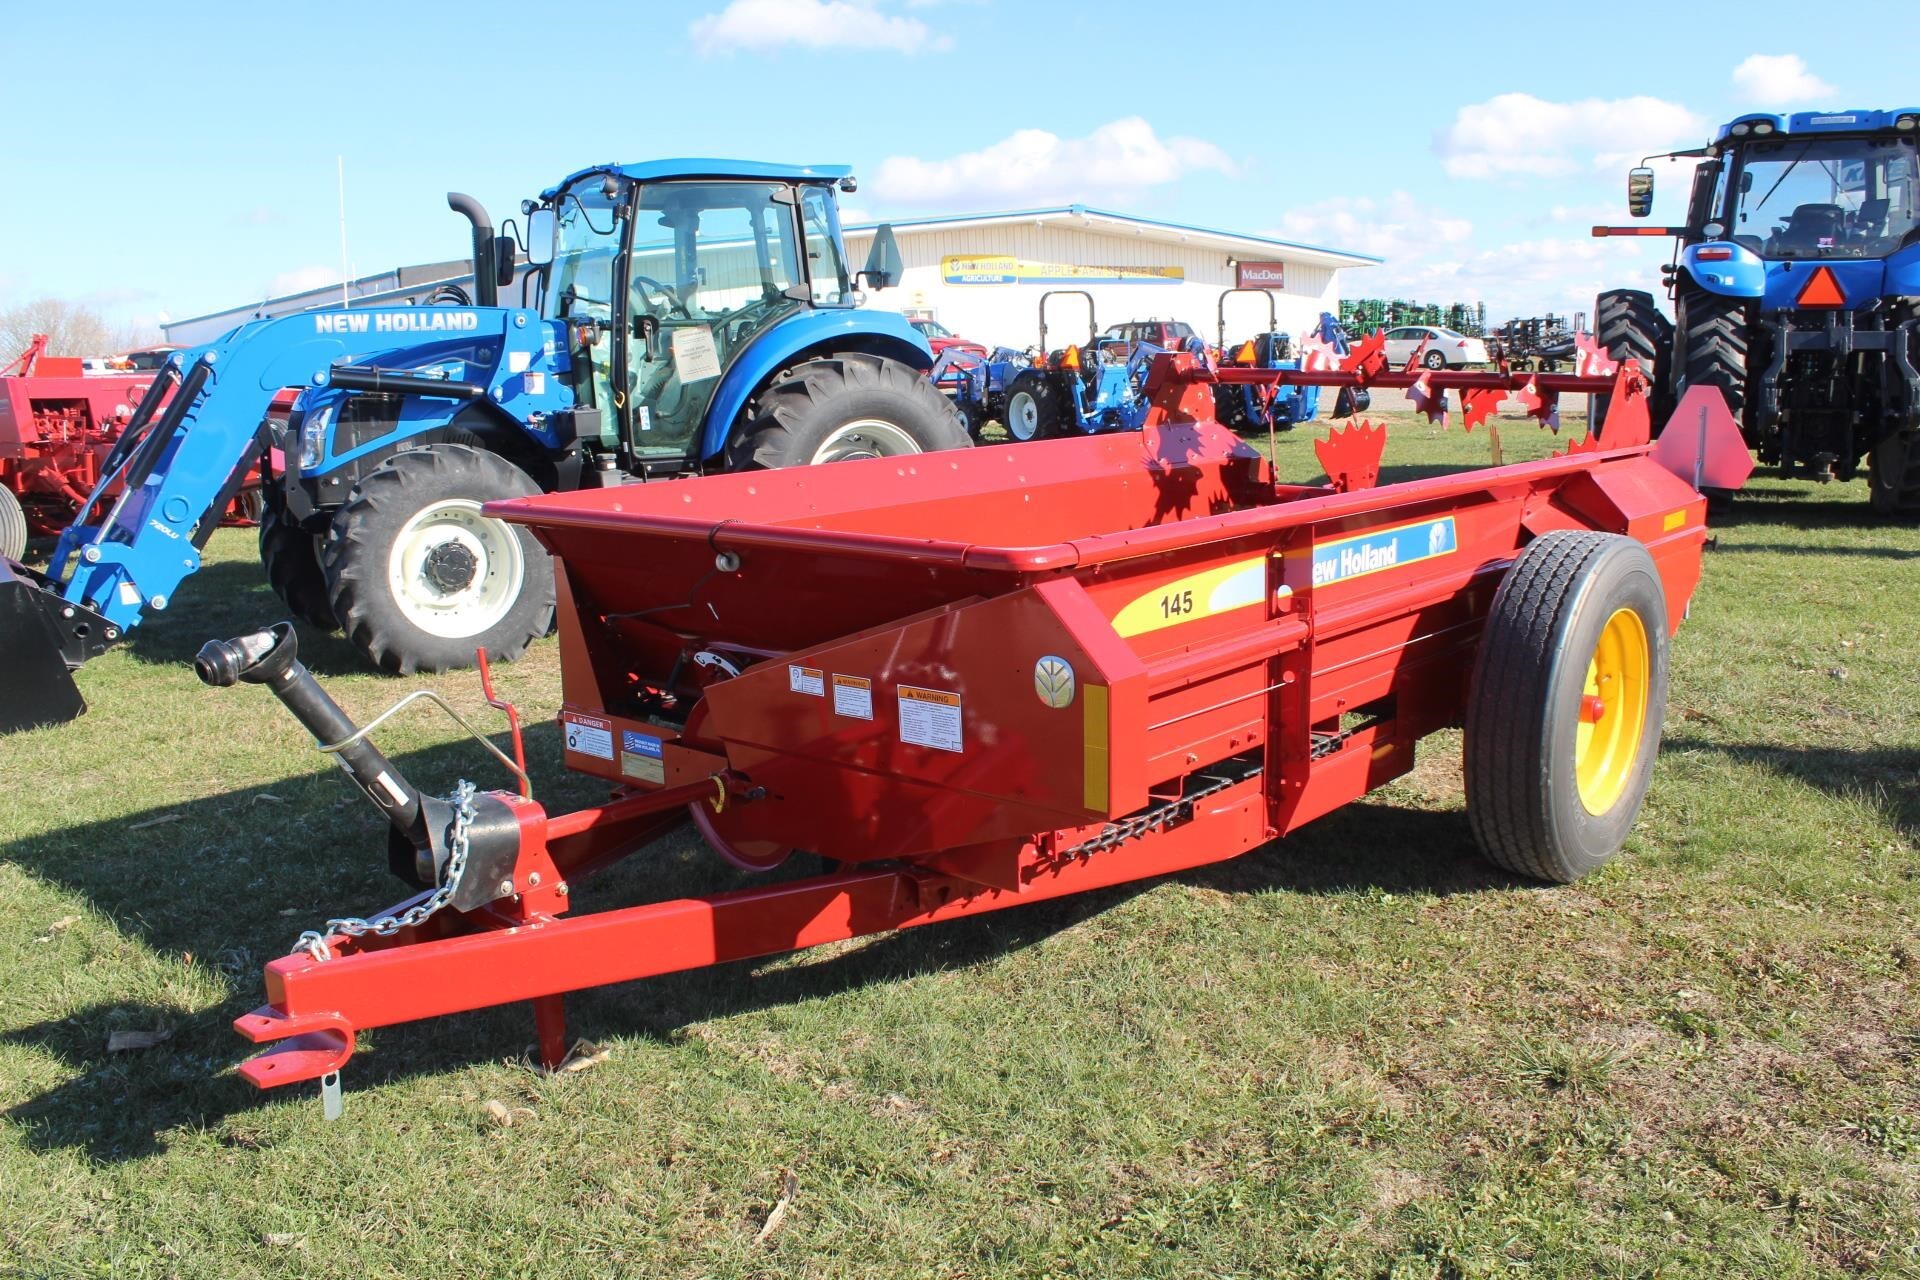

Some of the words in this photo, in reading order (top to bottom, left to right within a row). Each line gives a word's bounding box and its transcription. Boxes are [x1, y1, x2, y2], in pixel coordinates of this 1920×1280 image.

[961, 262, 978, 271] NEW
[980, 262, 1014, 271] HOLLAND
[1040, 265, 1074, 277] APPLE
[1078, 265, 1105, 277] FARM
[1107, 266, 1147, 277] SERVICE
[961, 274, 1003, 283] AGRICULTURE
[1241, 269, 1283, 280] MacDon
[315, 314, 370, 334] NEW
[375, 312, 478, 332] HOLLAND
[1313, 559, 1338, 584] ew
[1340, 537, 1398, 578] Holland
[1160, 590, 1193, 619] 145
[915, 690, 949, 704] WARNING
[578, 717, 604, 729] DANGER
